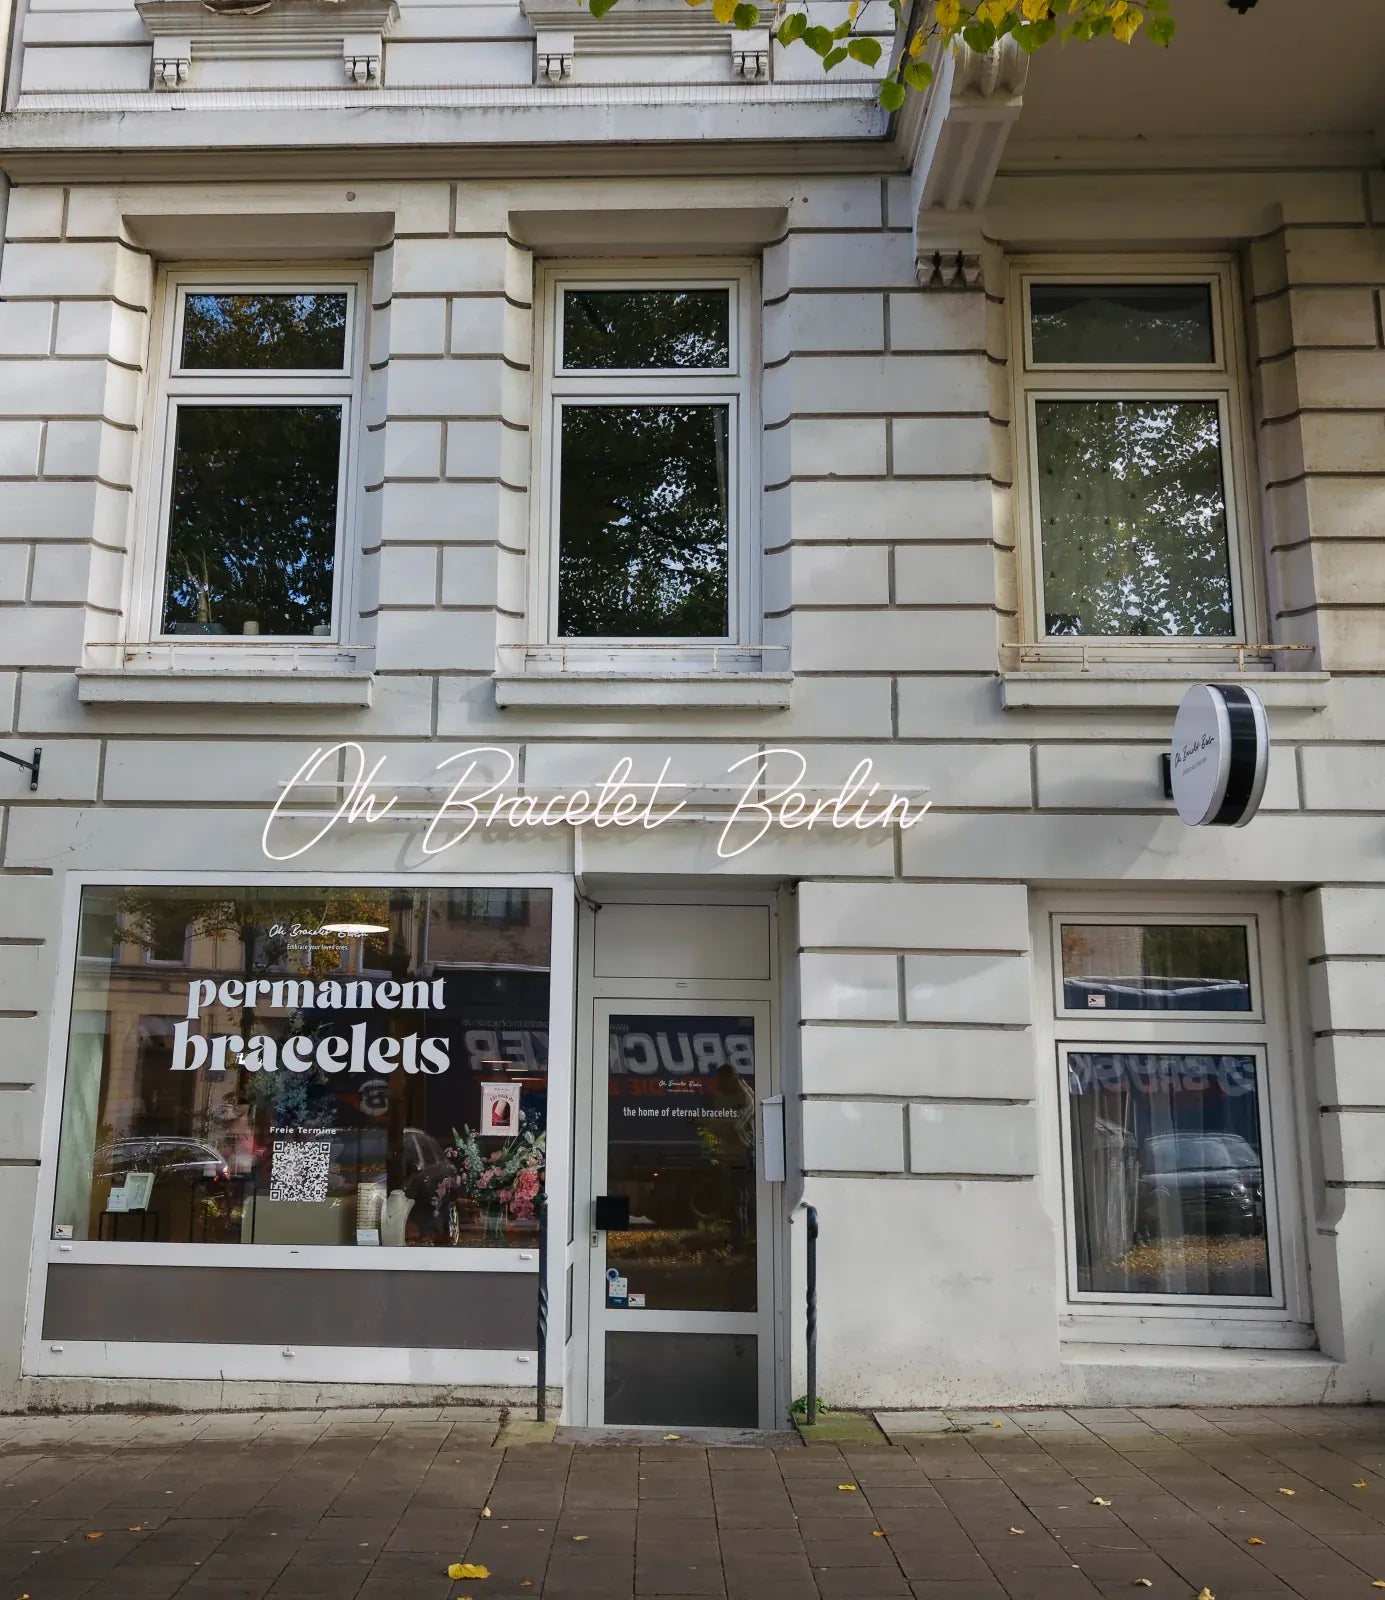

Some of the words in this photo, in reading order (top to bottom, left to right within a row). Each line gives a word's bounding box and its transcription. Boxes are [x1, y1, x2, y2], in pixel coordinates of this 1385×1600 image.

[262, 742, 398, 860] Oh
[422, 747, 687, 854] Bracelet
[717, 748, 933, 858] Berlin
[269, 924, 287, 938] Oh
[286, 943, 308, 951] Embrace
[308, 944, 320, 953] your
[321, 943, 335, 951] loved
[186, 977, 447, 1020] permanent
[169, 1020, 451, 1075] bracelets
[623, 1106, 637, 1117] the
[638, 1107, 660, 1117] home
[661, 1107, 670, 1117] of
[671, 1107, 700, 1117] eternal
[269, 1125, 295, 1134] Freie
[297, 1126, 337, 1135] Termine
